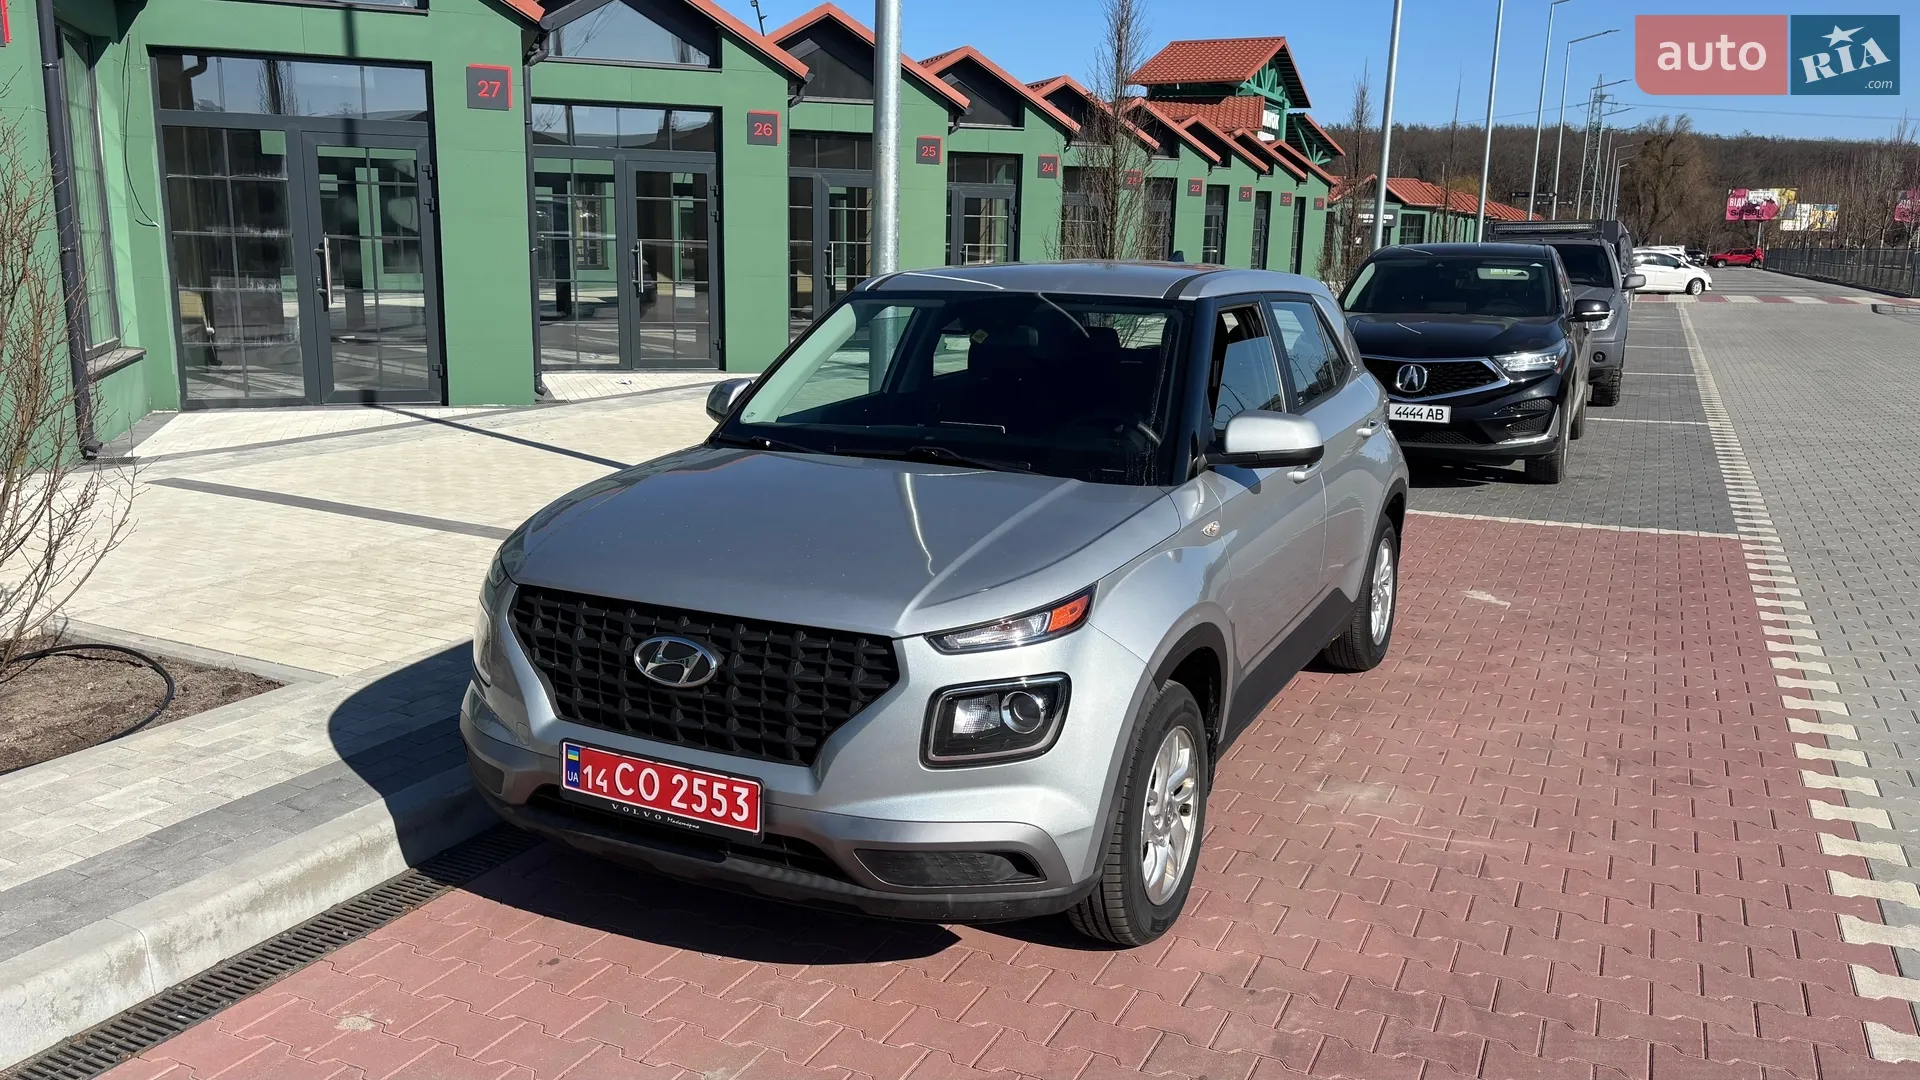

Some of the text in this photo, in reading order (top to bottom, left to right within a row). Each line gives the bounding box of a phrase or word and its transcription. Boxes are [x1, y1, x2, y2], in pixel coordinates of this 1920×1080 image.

[477, 80, 501, 98] 27
[753, 122, 773, 136] 26
[921, 145, 937, 158] 25
[1041, 162, 1055, 173] 24
[1191, 184, 1200, 192] 22
[1395, 406, 1445, 421] 4444 AB
[567, 770, 579, 783] UA
[671, 774, 750, 823] 2553
[611, 803, 662, 820] VOLVO
